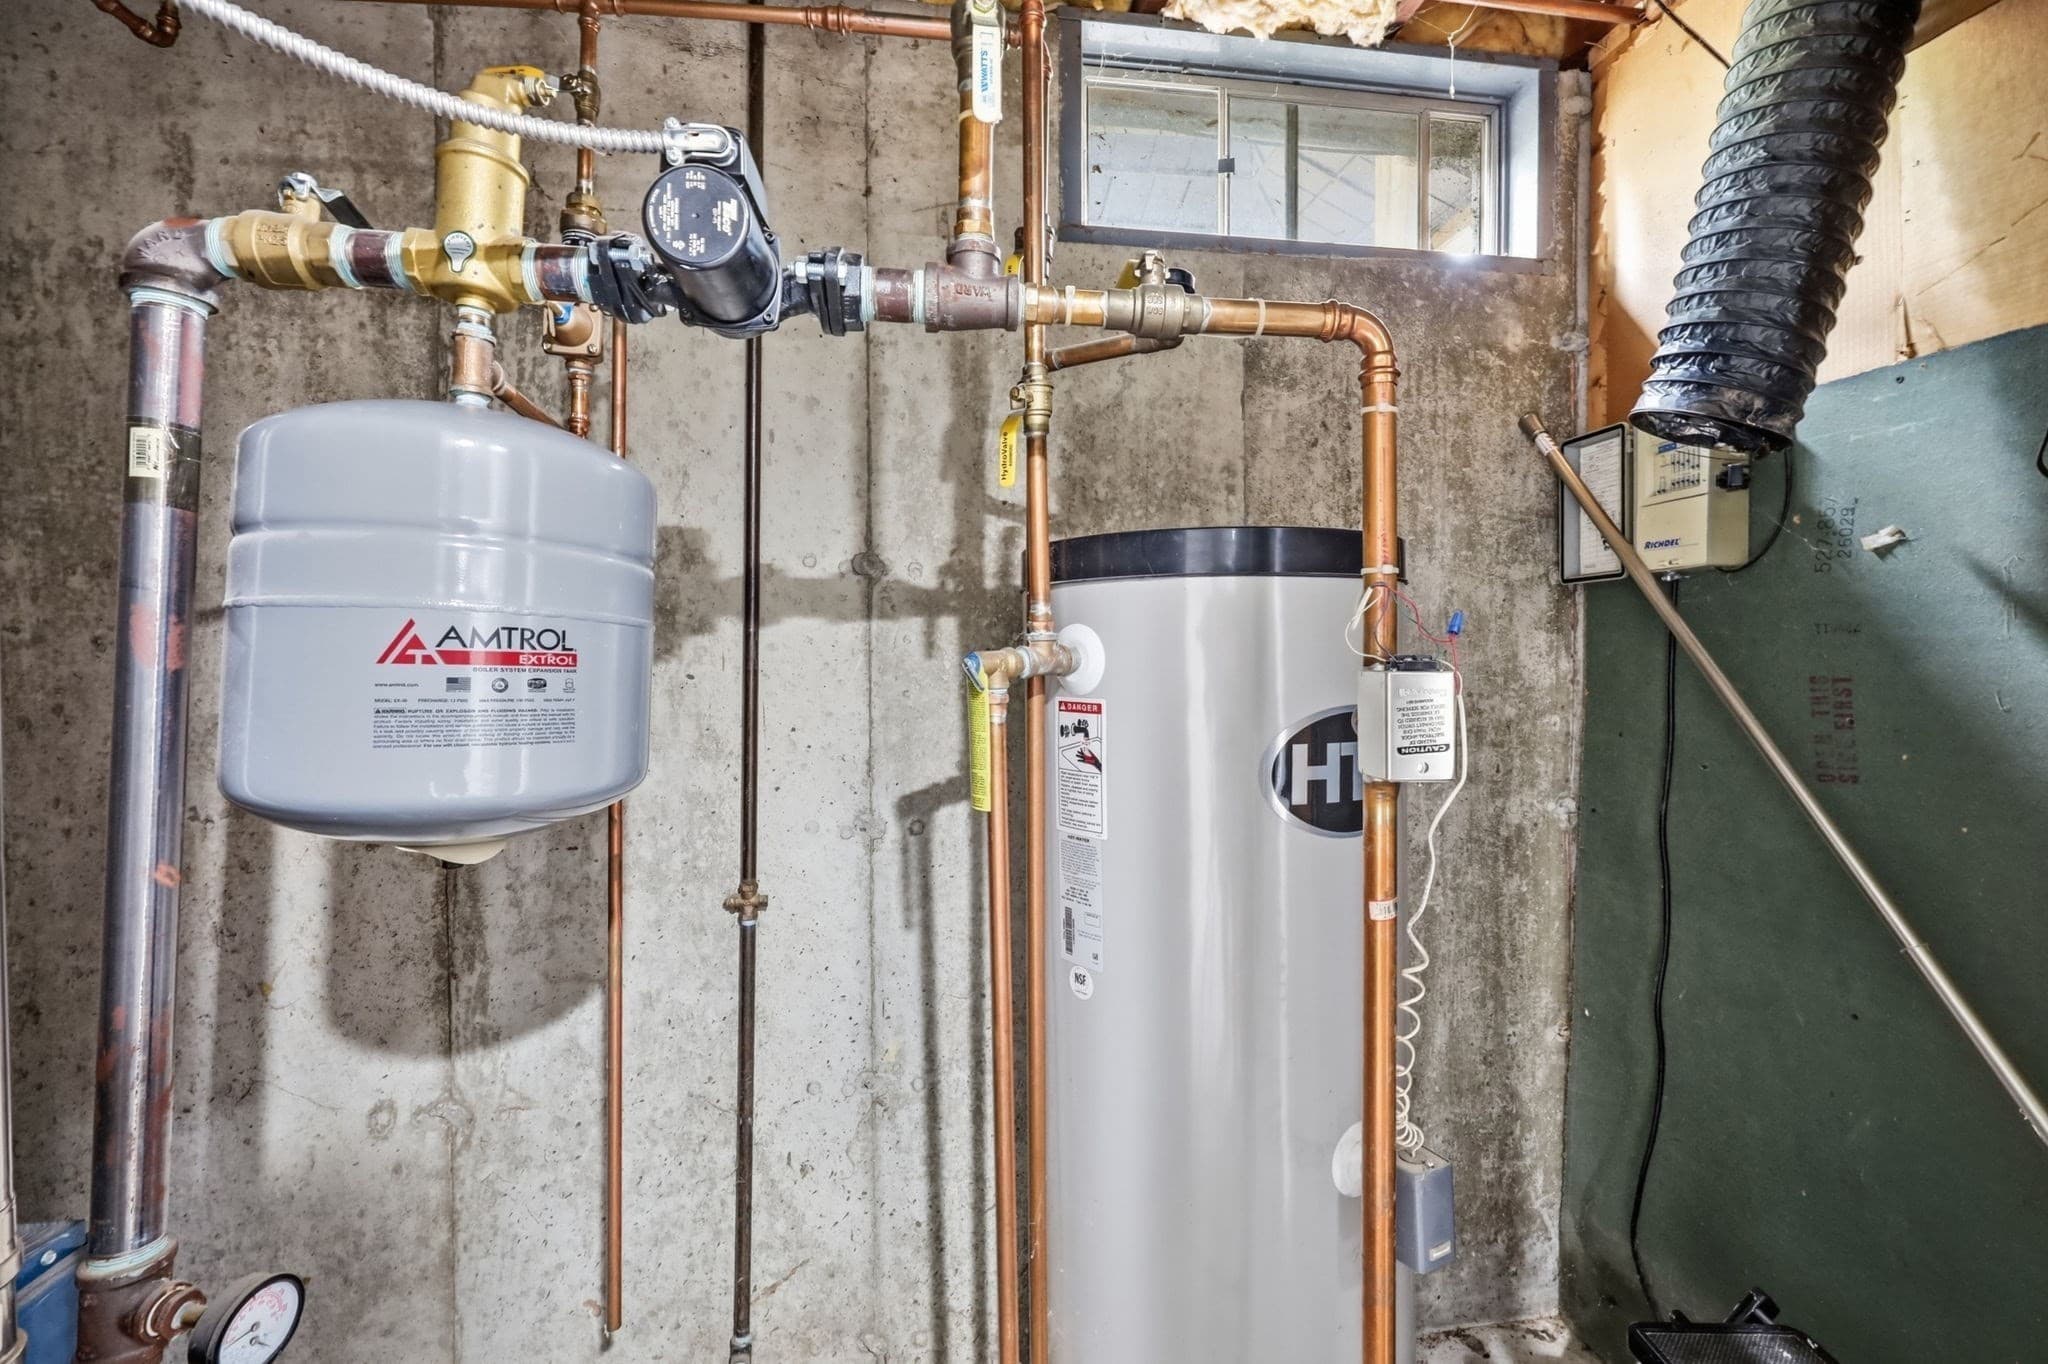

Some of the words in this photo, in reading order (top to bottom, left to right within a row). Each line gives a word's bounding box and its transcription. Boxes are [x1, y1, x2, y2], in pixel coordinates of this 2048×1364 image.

[1001, 431, 1009, 481] HydroValve
[1644, 538, 1681, 550] RICHDEL
[435, 624, 577, 652] AMTROL
[518, 653, 576, 666] EXTROL
[1066, 702, 1098, 712] DANGER
[1401, 745, 1447, 754] CAUTION
[1074, 972, 1087, 986] NSF
